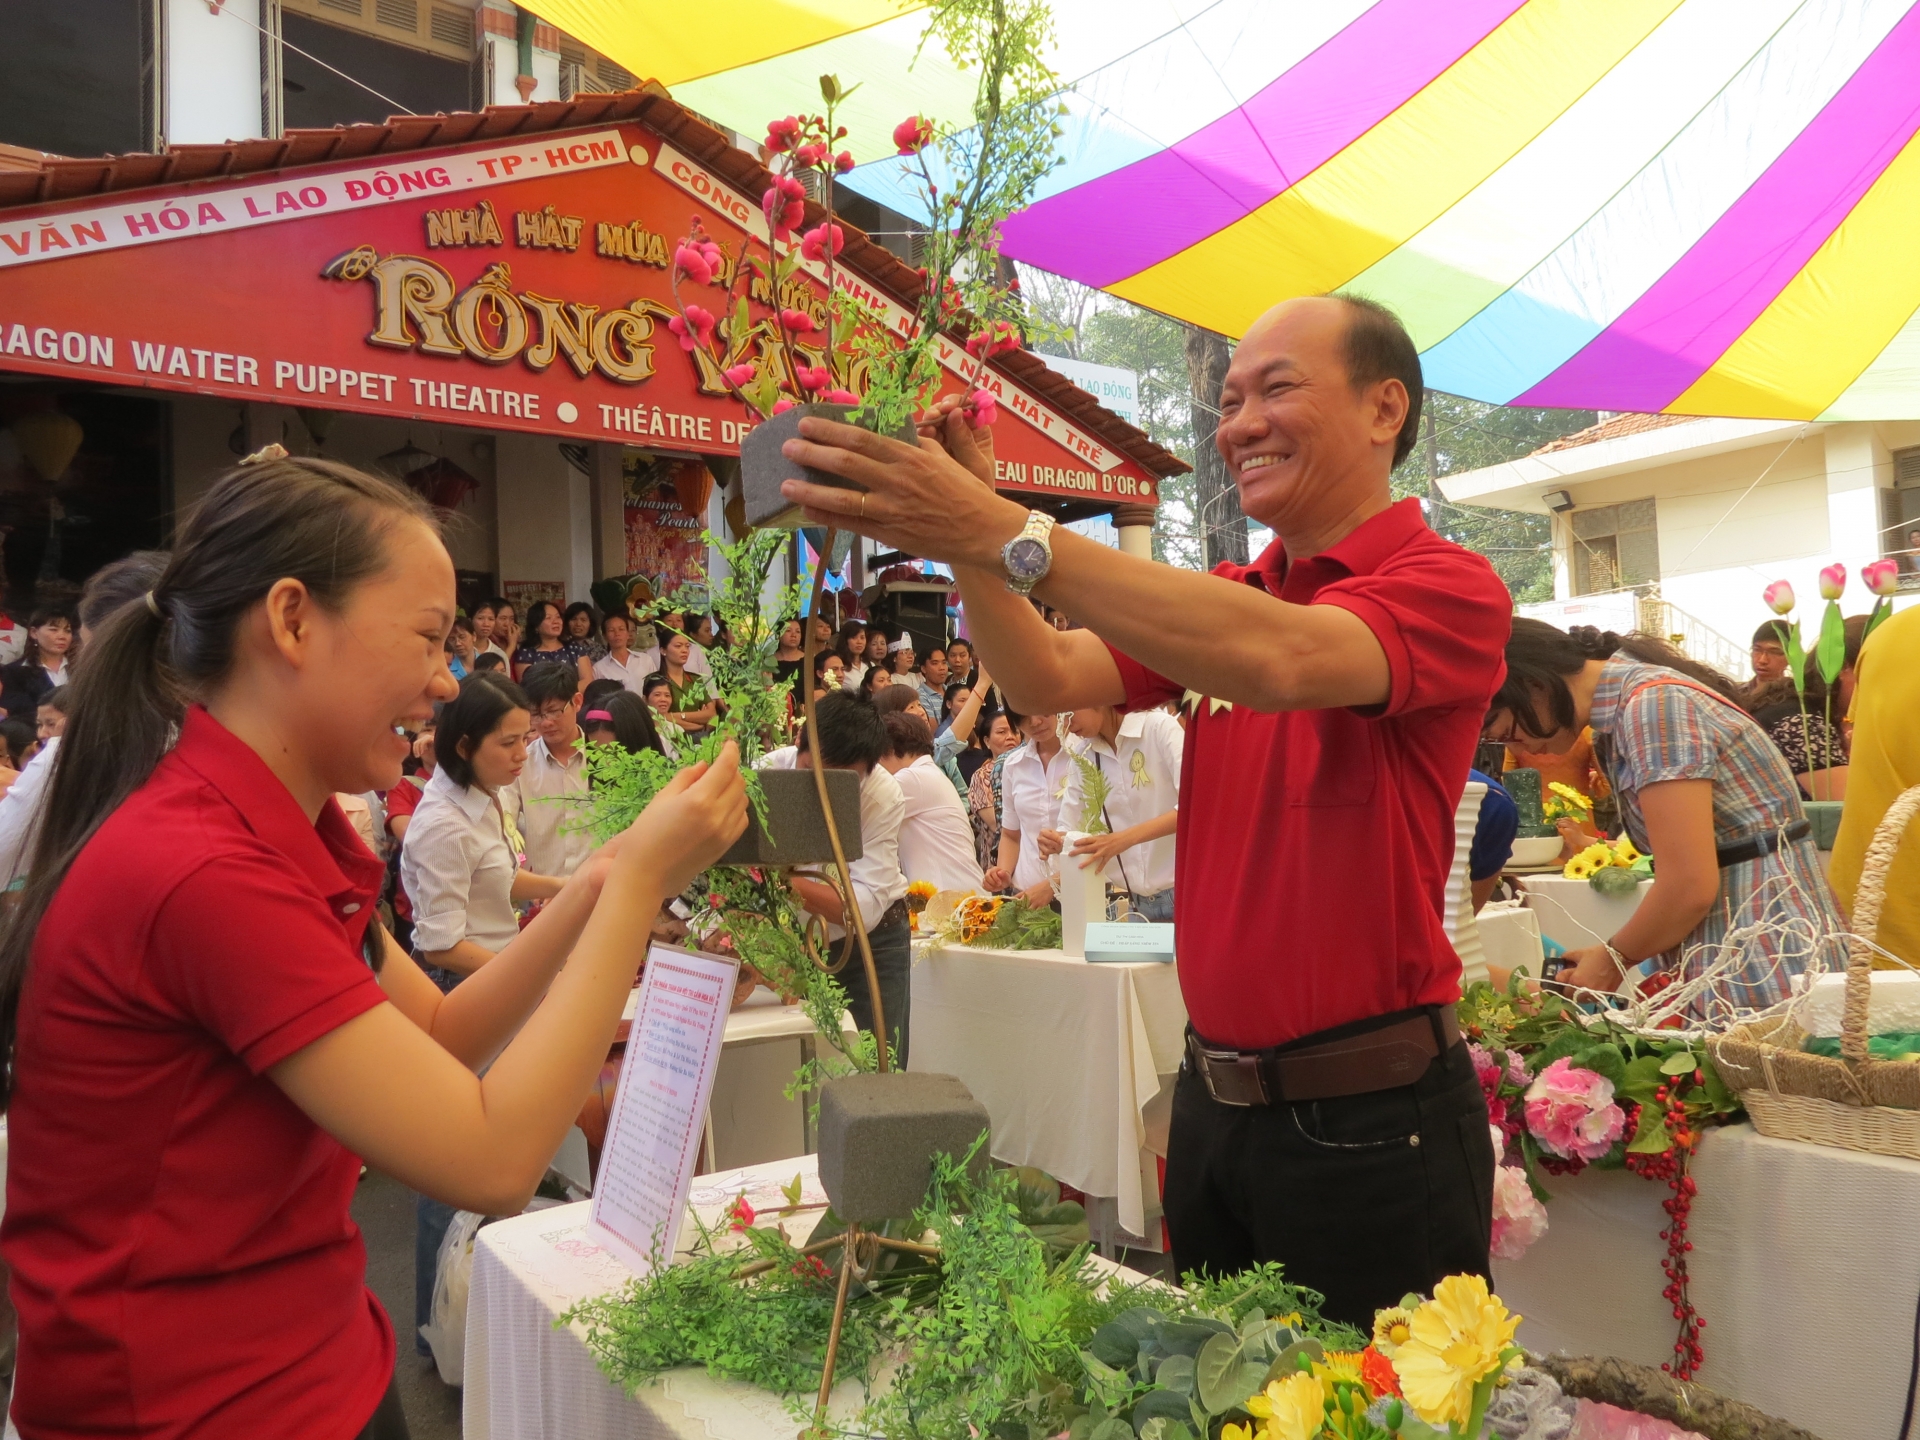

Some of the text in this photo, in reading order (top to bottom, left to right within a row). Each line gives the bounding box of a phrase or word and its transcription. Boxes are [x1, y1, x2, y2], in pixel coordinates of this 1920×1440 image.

[0, 221, 107, 257] VĂN
[124, 201, 226, 237] HÓA
[243, 186, 328, 218] LAO
[344, 169, 451, 201] ĐỘNG
[424, 199, 503, 249] NHÀ
[515, 204, 585, 252] HÁT
[596, 220, 671, 268] MÚA
[671, 161, 750, 224] CÔNG
[959, 358, 1003, 398] NHÀ
[1012, 393, 1055, 430] HÁT
[1065, 429, 1103, 465] TRẺ
[0, 323, 541, 420] AGON WATER PUPPET THEATRE
[1103, 380, 1132, 400] ĐỘNG
[598, 402, 712, 442] THÉÂTRE
[721, 420, 758, 445] DE
[1032, 465, 1097, 492] DRAGON
[1102, 470, 1137, 495] D'OR
[655, 511, 700, 529] Pearls
